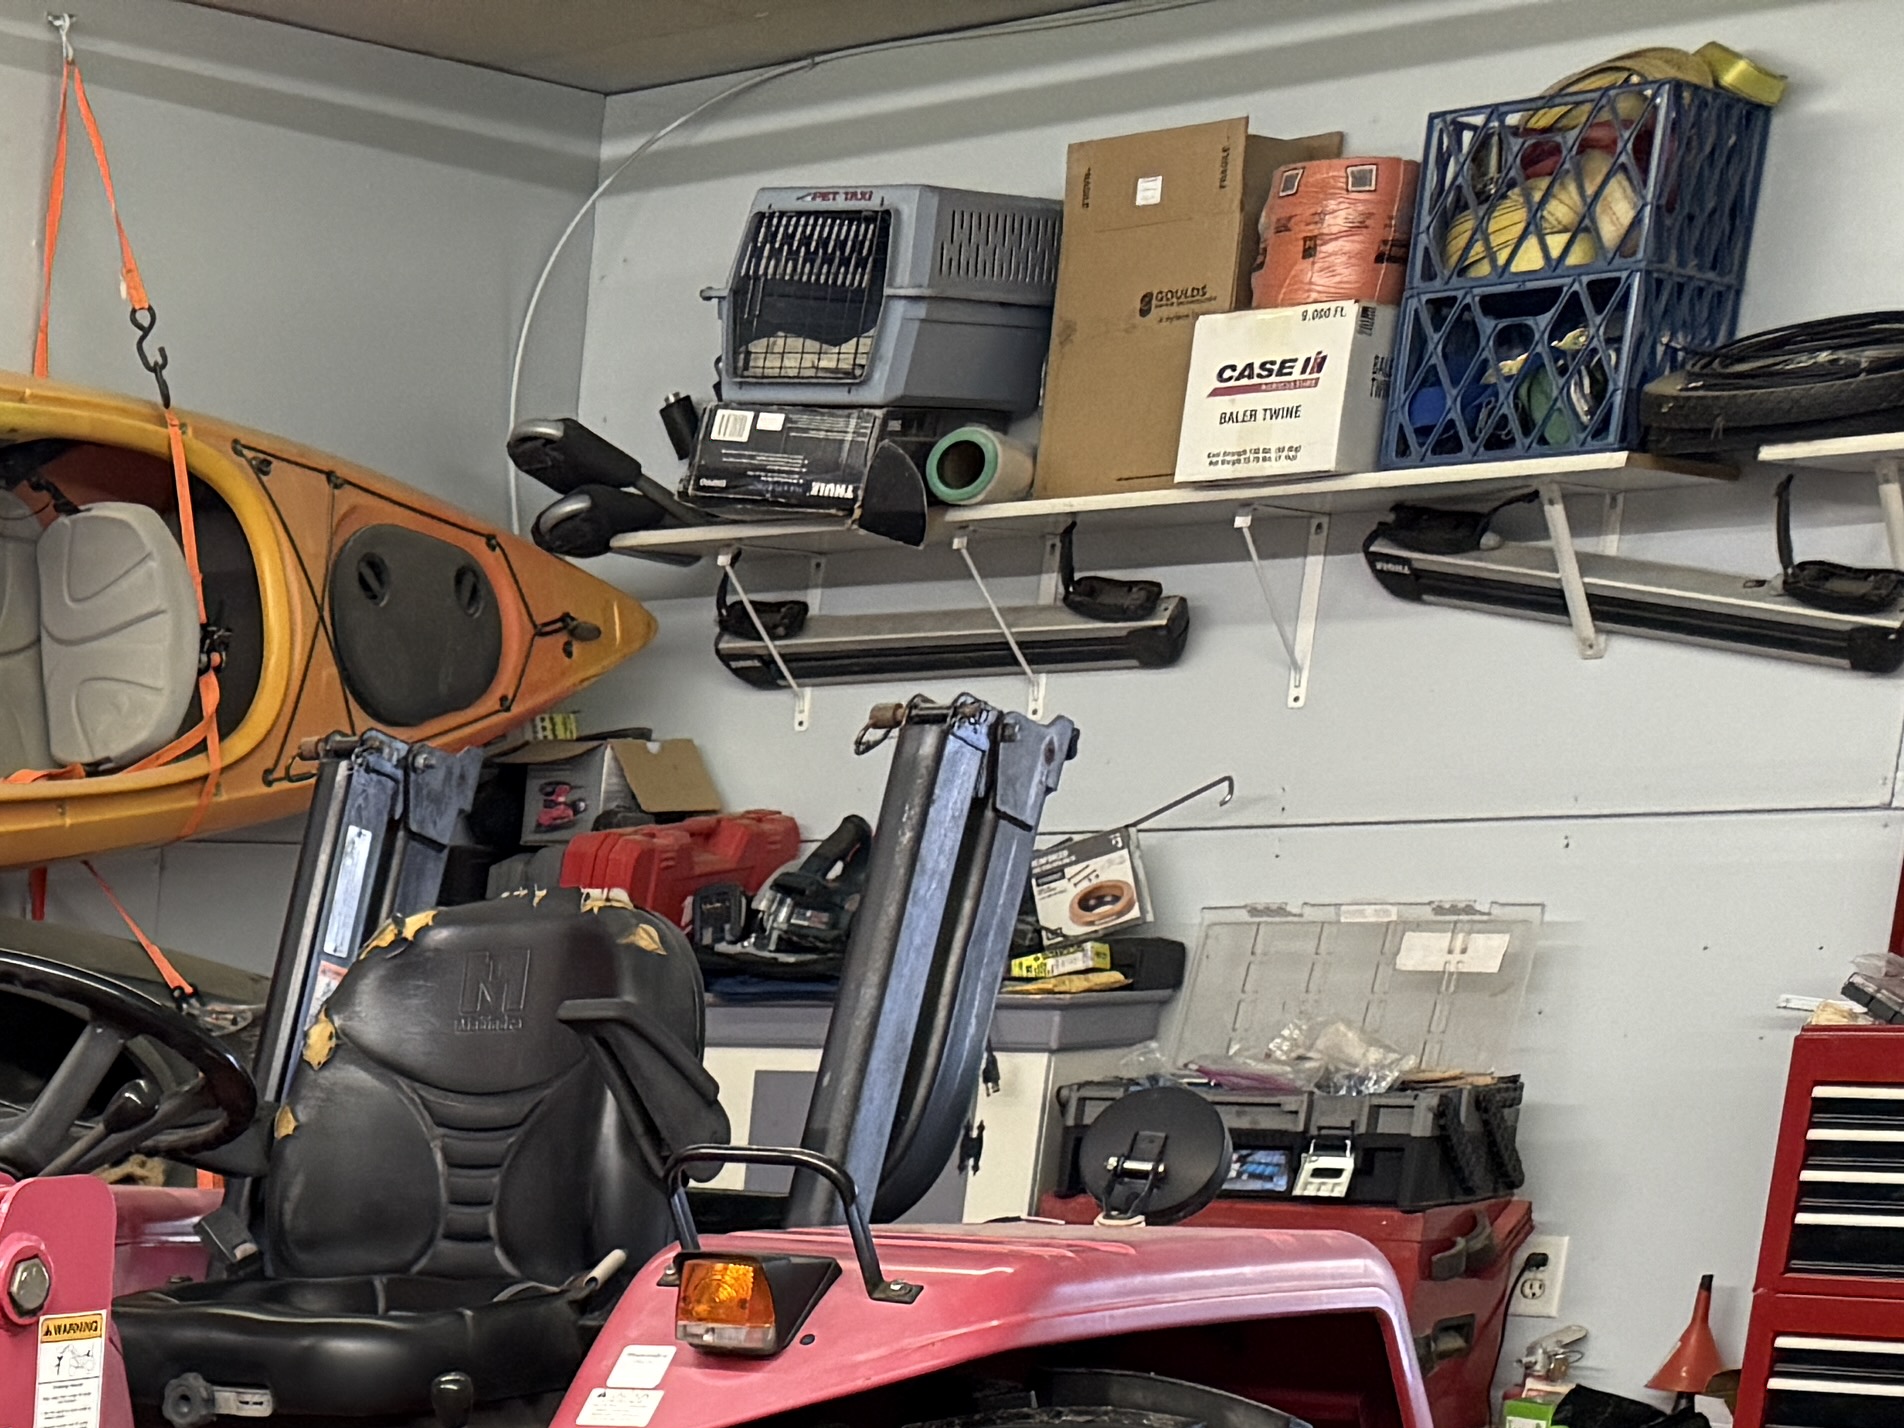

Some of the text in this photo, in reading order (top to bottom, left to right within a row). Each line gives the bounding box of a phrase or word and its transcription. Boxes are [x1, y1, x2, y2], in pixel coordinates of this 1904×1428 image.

[1155, 284, 1207, 302] GOULDS
[1216, 358, 1299, 384] CASE
[1219, 405, 1302, 426] BALER TWINE
[54, 1320, 99, 1336] WARNING
